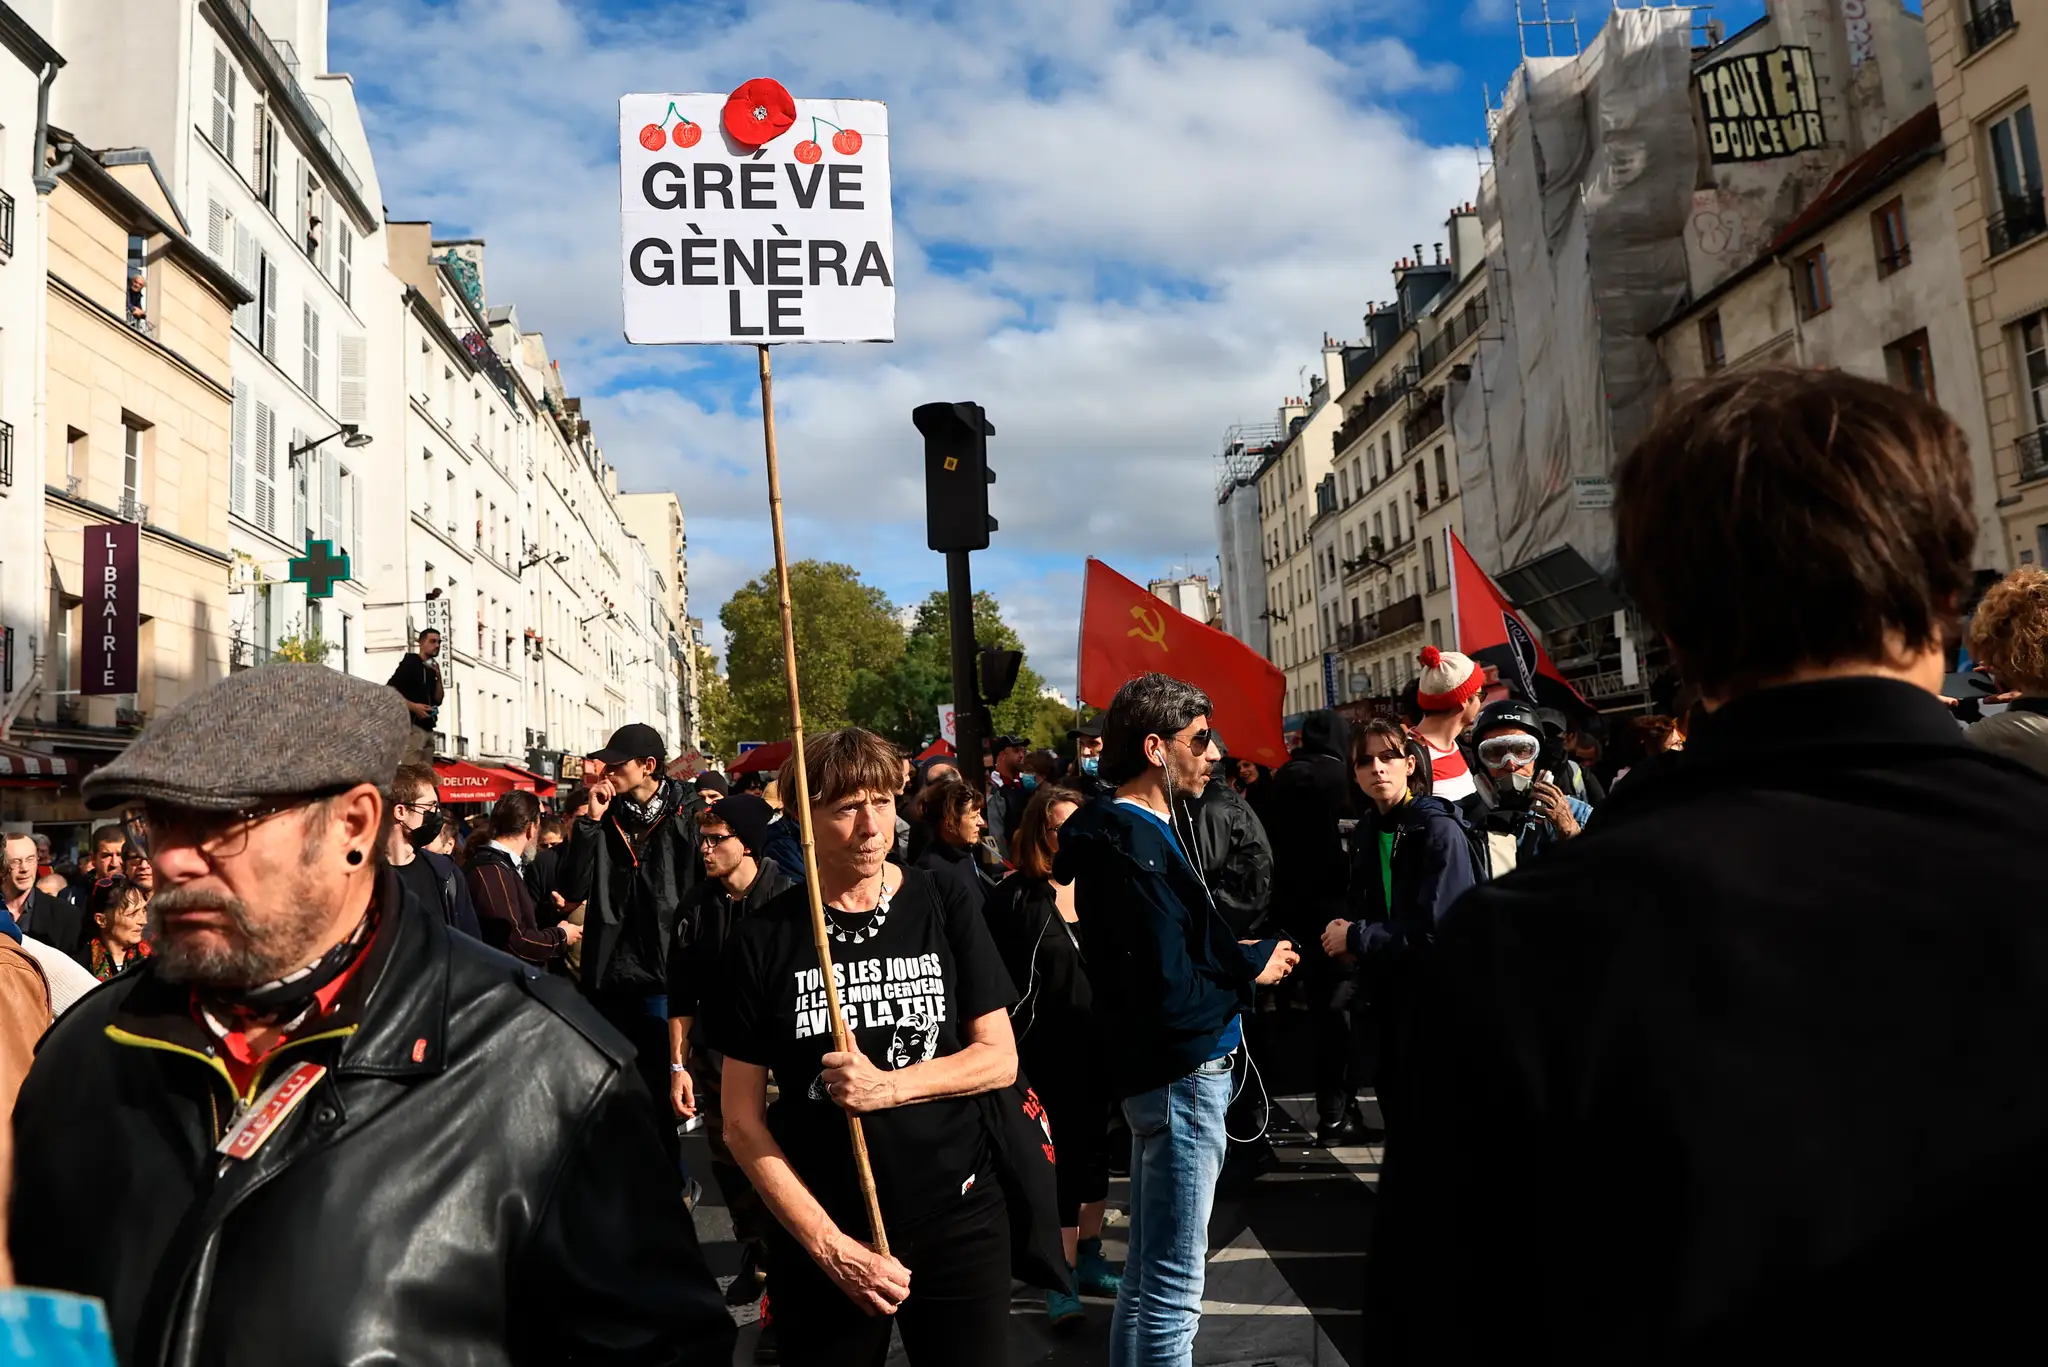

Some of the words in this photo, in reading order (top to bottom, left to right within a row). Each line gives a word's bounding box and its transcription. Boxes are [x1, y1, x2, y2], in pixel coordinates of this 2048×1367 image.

[1701, 57, 1768, 118] TOUT
[1766, 49, 1818, 115] EN
[1709, 113, 1823, 158] DOUCEUR
[629, 223, 893, 286] GÈNÈRA
[729, 289, 804, 336] LE
[103, 532, 117, 686] LIBRAIRIE
[443, 776, 489, 787] DELITALY
[848, 958, 883, 985] LES
[886, 952, 942, 981] JOURS
[795, 994, 809, 1012] JE
[811, 988, 846, 1008] LAE
[848, 984, 882, 1003] MON
[883, 978, 945, 999] CERVEAU
[795, 1004, 859, 1039] AVC
[863, 1000, 895, 1028] LA
